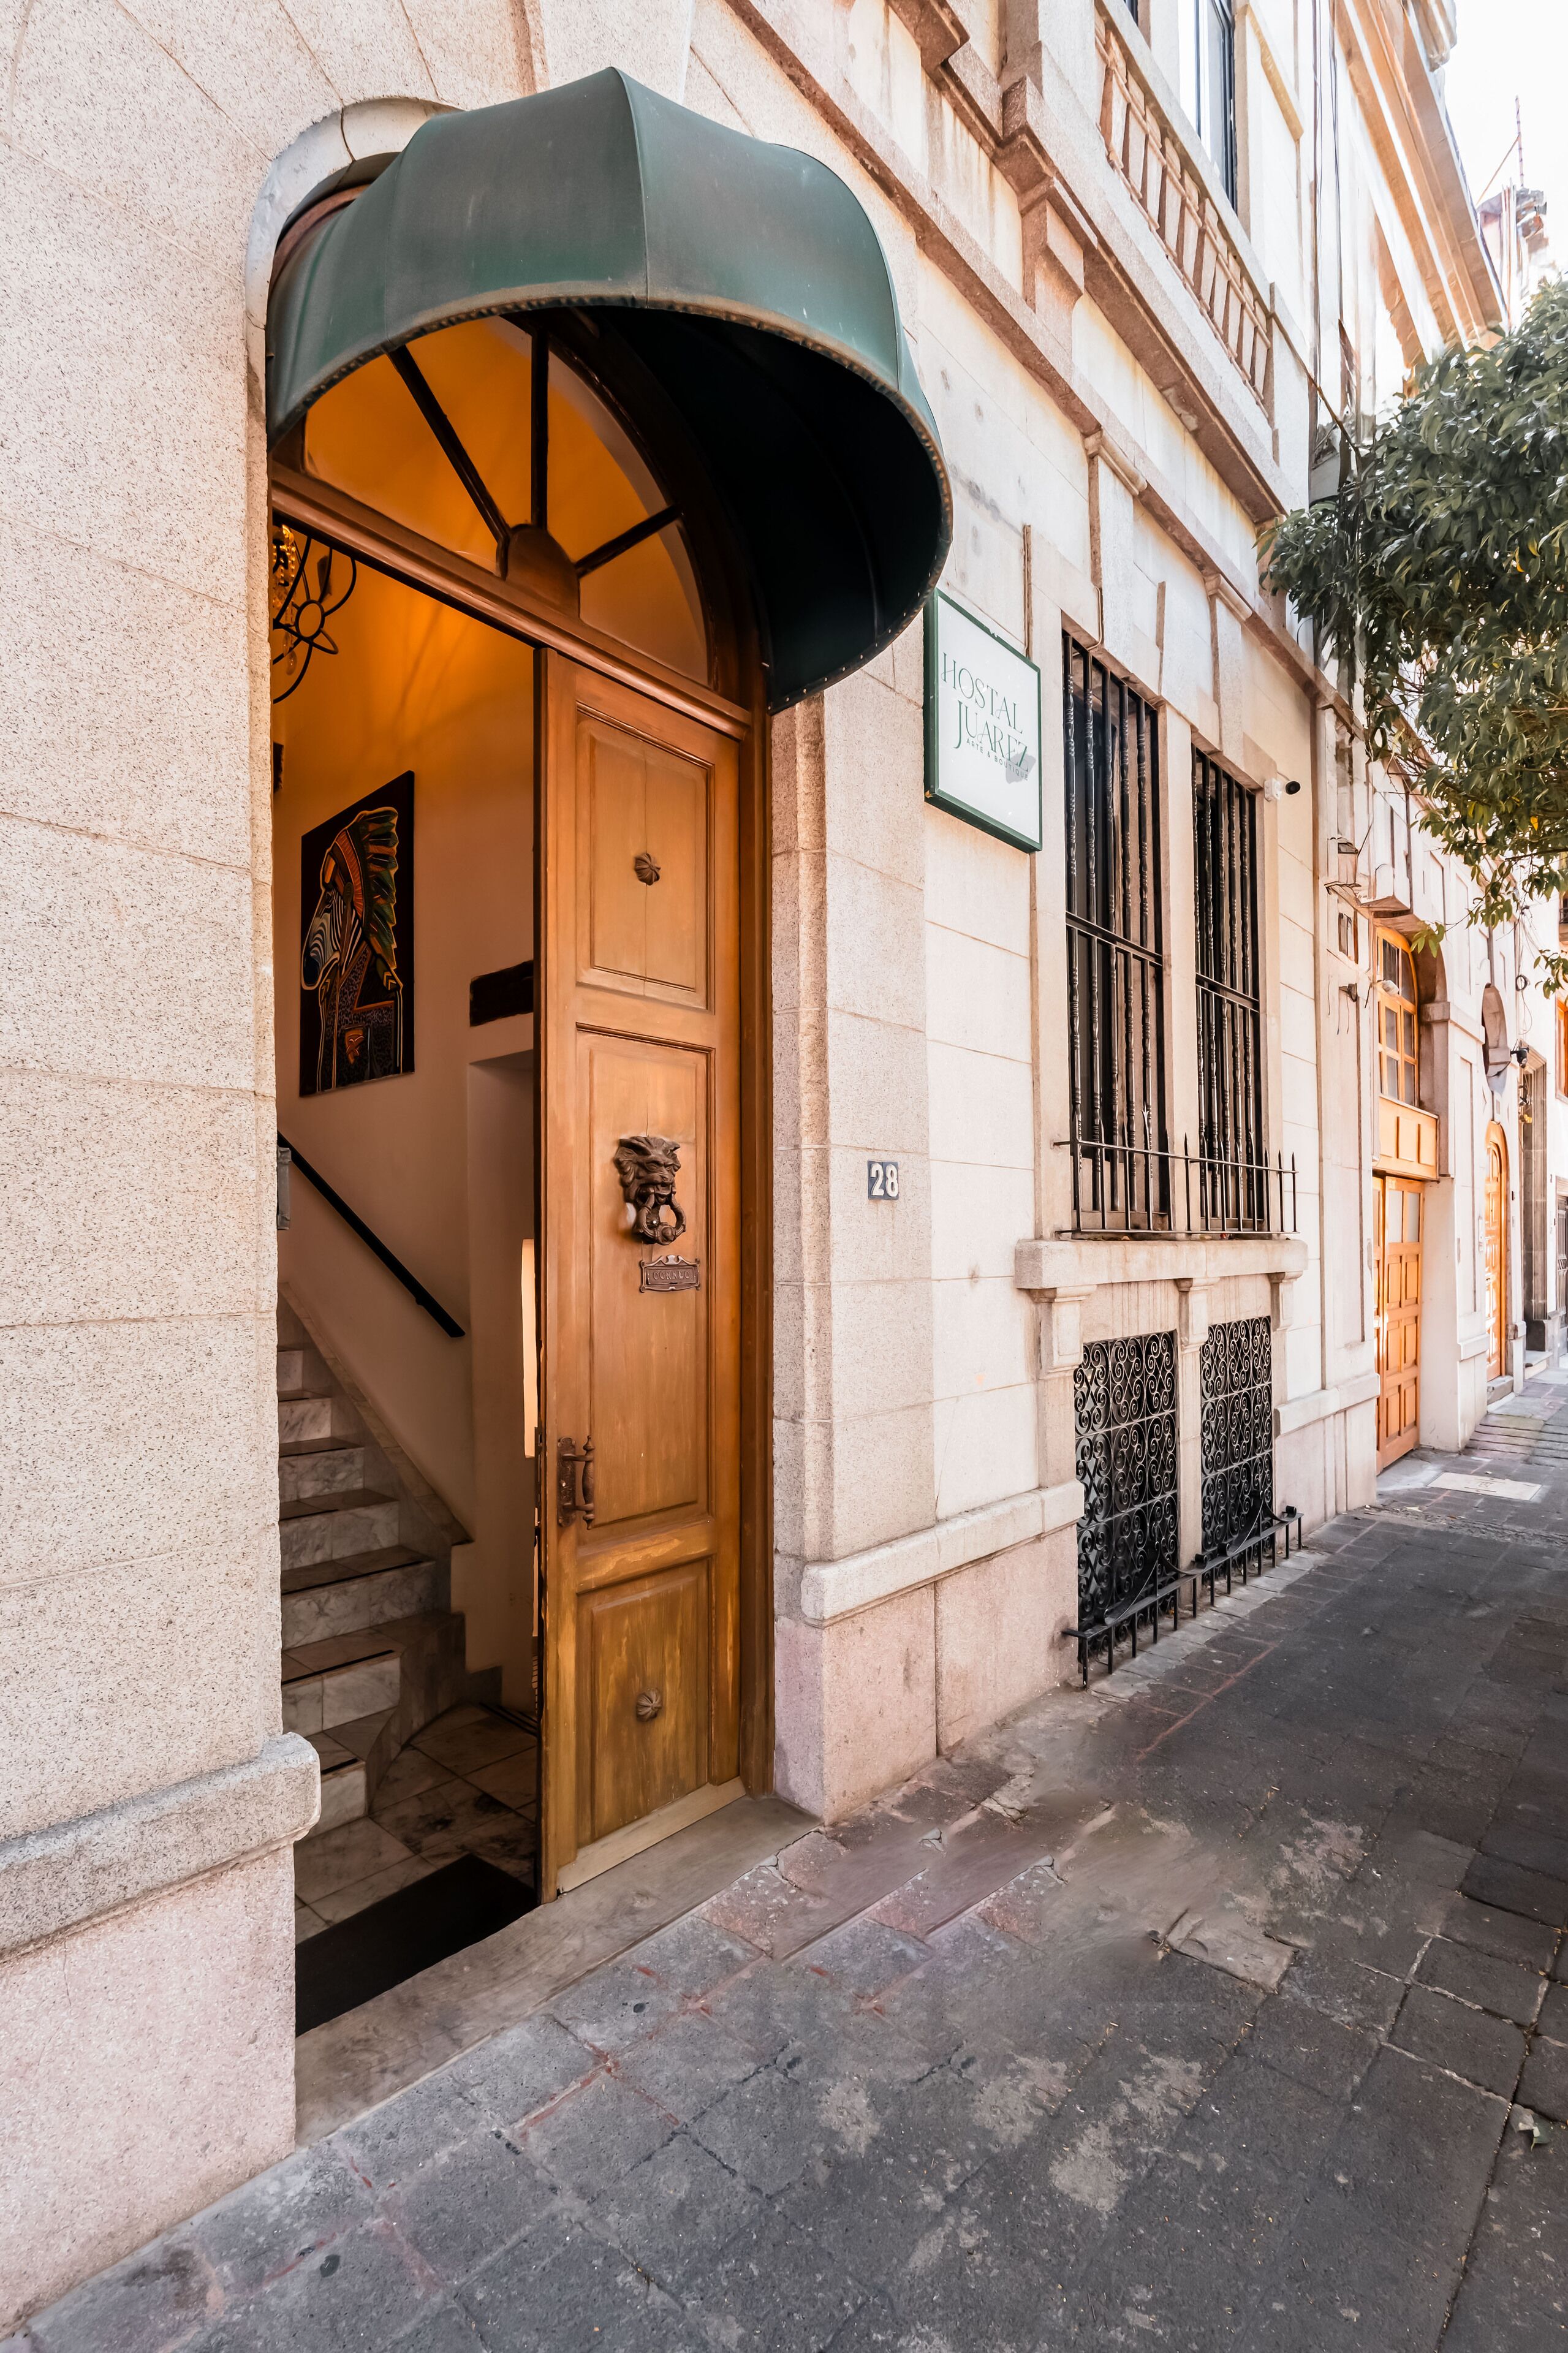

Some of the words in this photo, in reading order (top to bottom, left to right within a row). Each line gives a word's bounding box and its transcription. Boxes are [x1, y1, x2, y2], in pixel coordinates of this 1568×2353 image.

[941, 652, 1023, 734] HOSTAL
[953, 700, 1029, 773] JUAREZ
[966, 738, 983, 754] ARTE
[994, 755, 1028, 781] BOUTIQUE
[870, 1162, 899, 1197] 28
[653, 1270, 690, 1280] CORREO
